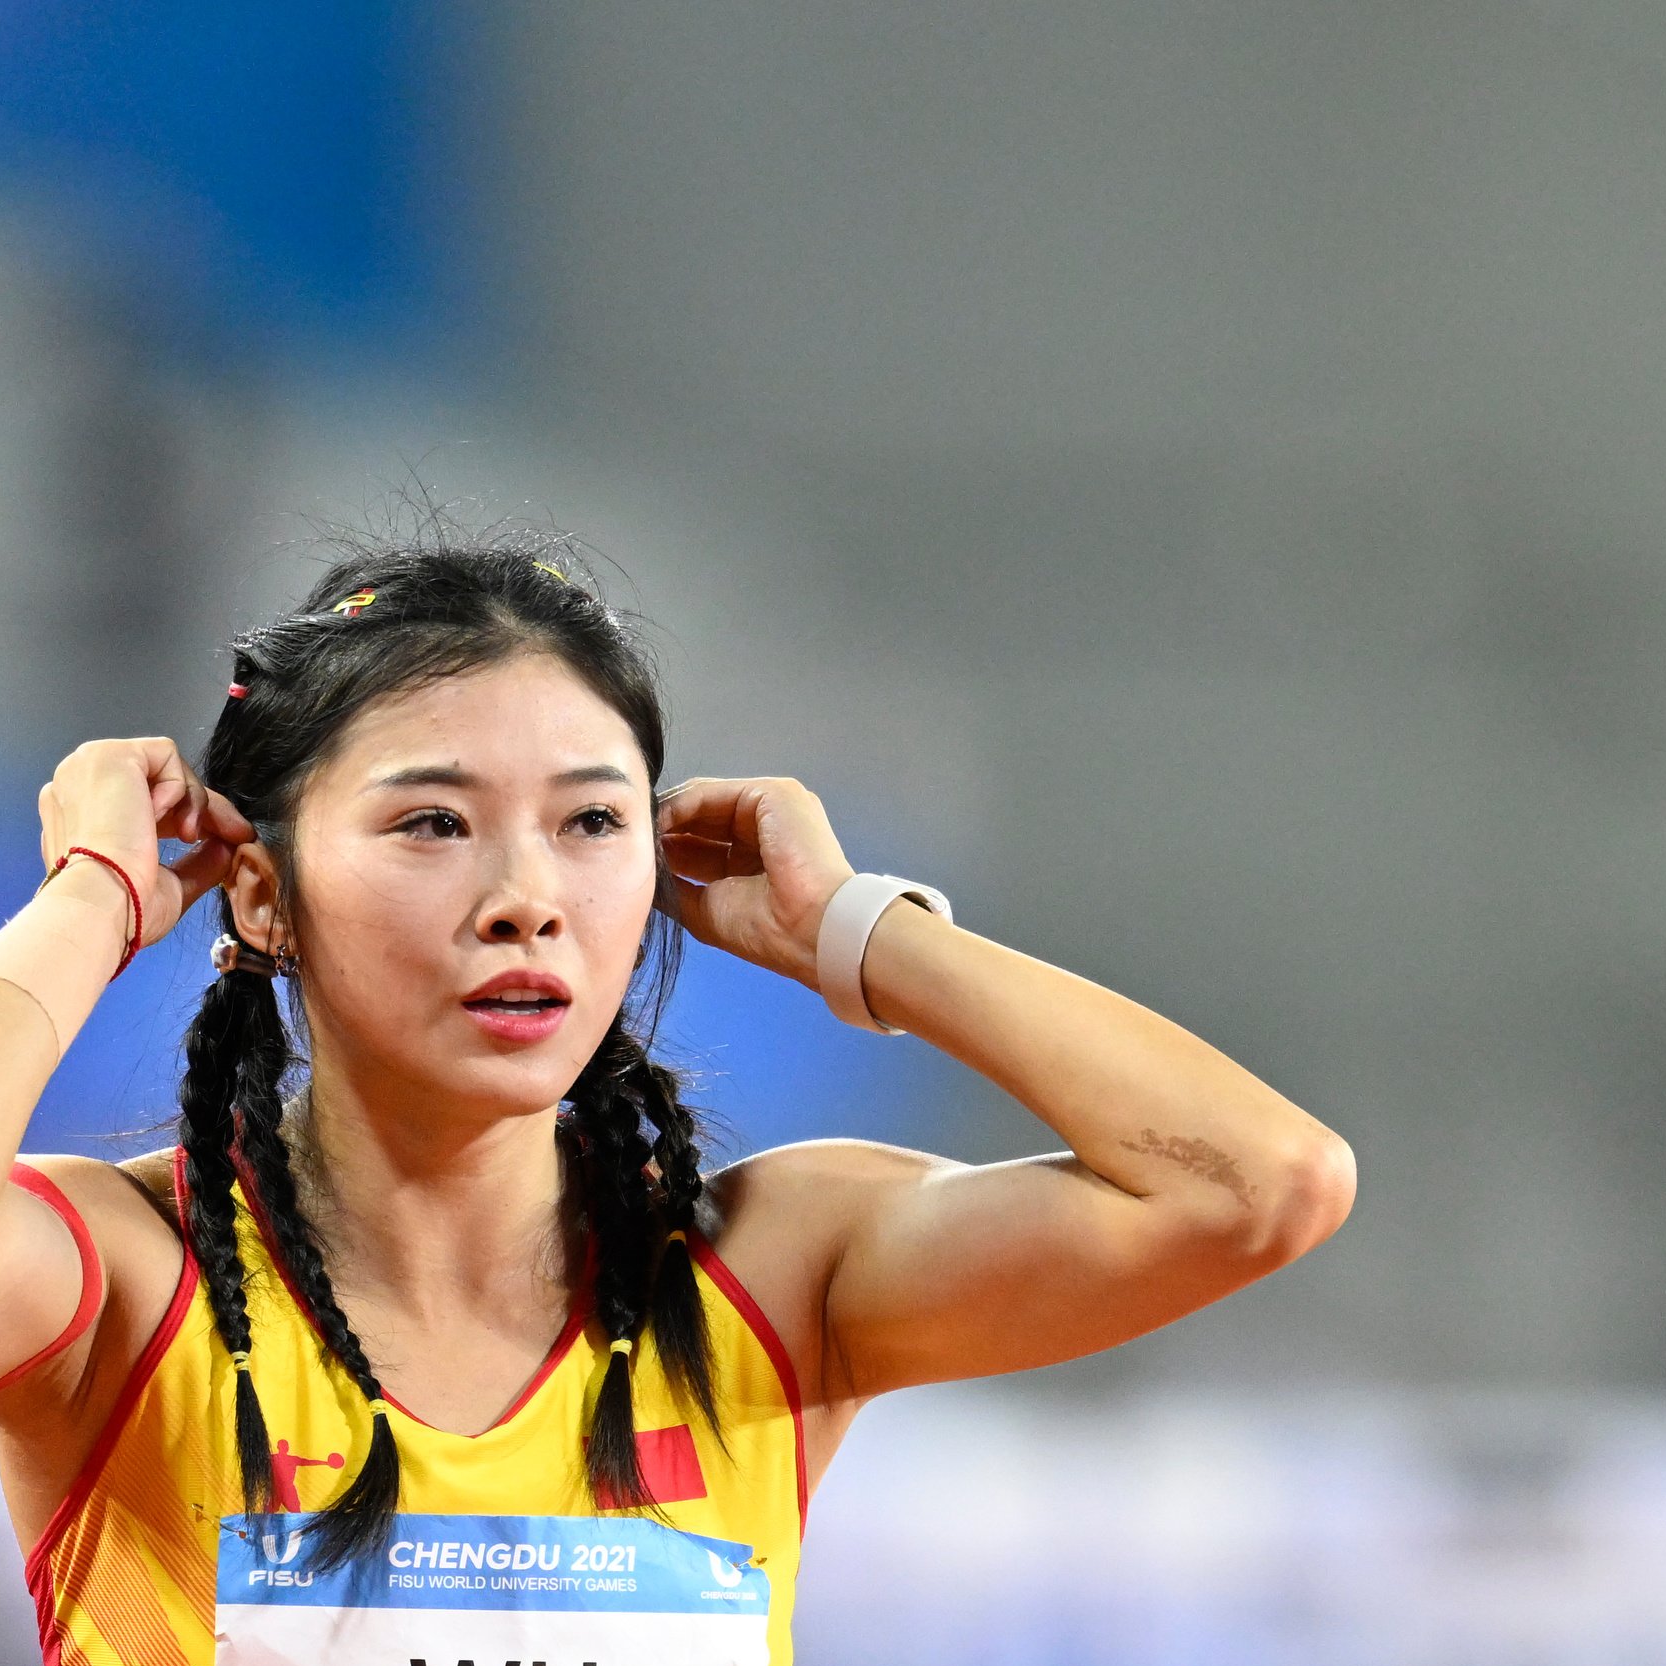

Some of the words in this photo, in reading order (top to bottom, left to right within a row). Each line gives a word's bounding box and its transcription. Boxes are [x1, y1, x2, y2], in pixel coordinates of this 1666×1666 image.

[388, 1541, 560, 1571] CHENGDU
[571, 1545, 636, 1572] 2021
[248, 1569, 313, 1587] FISU
[389, 1574, 424, 1588] FISU
[428, 1576, 486, 1590] WORLD
[491, 1577, 580, 1591] UNIVERSITY
[585, 1578, 637, 1592] GAMES
